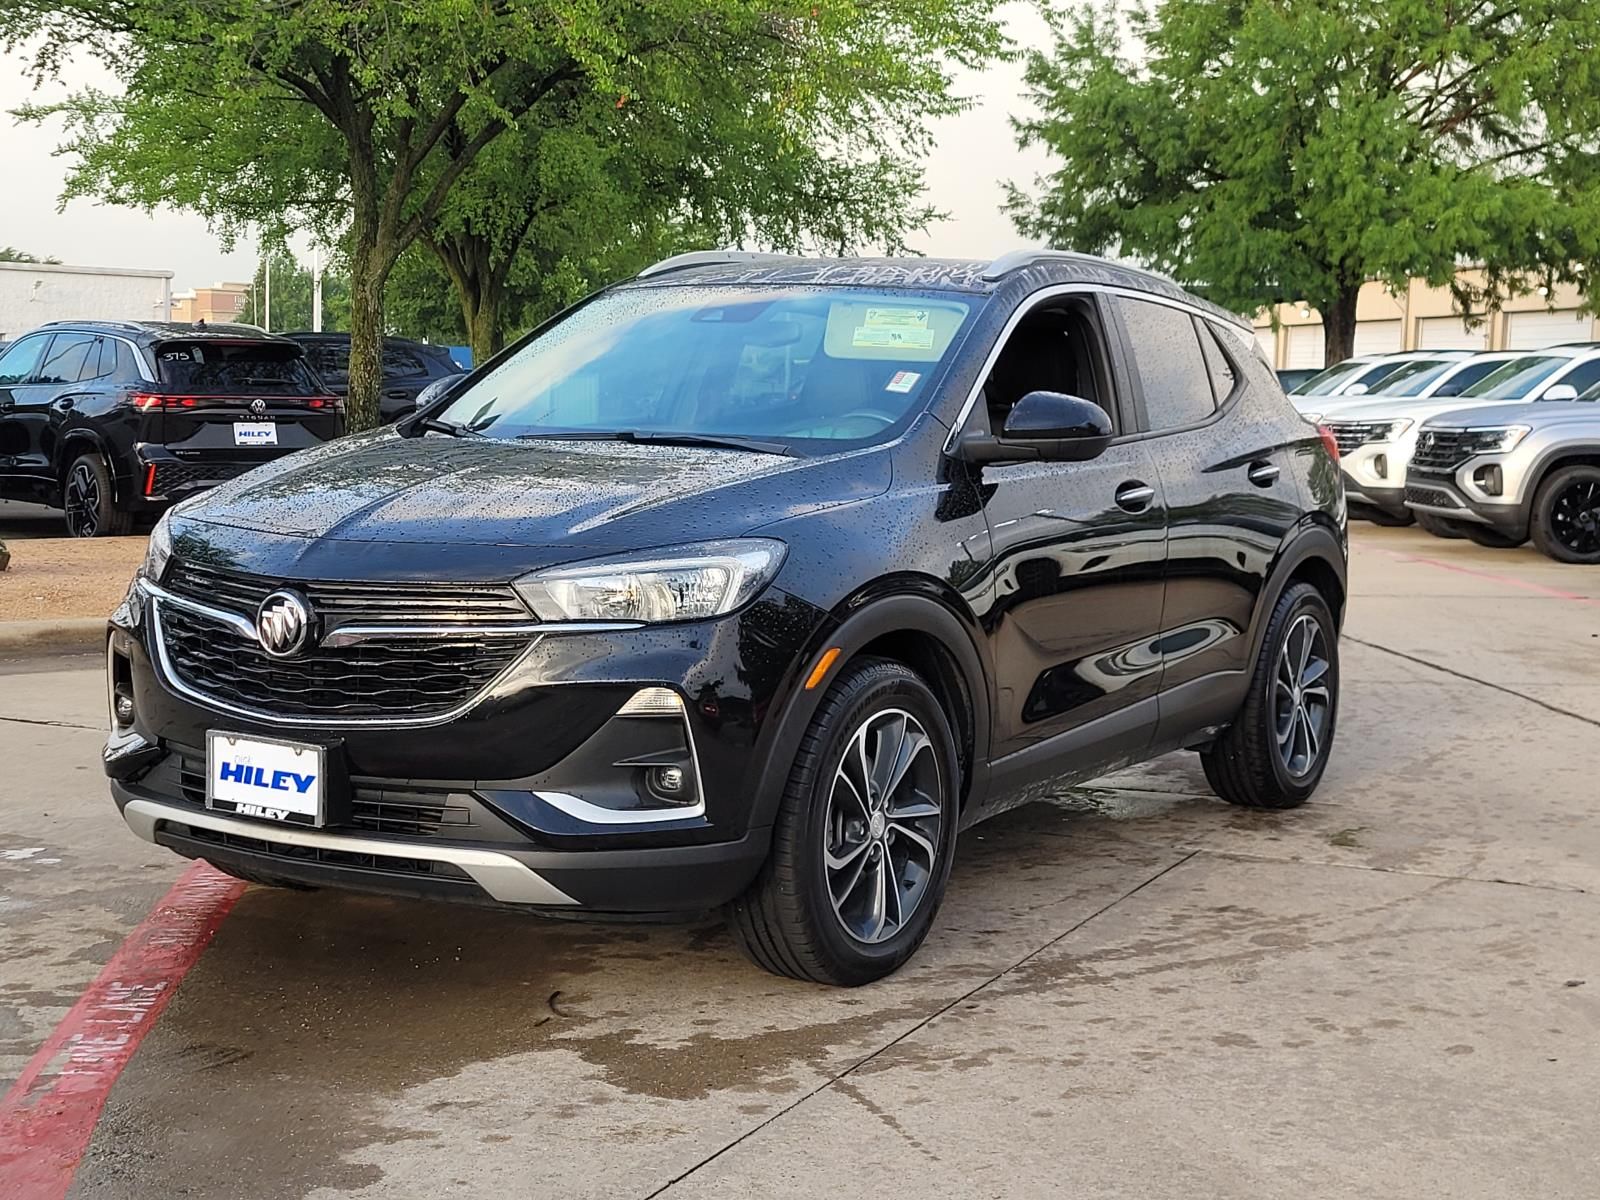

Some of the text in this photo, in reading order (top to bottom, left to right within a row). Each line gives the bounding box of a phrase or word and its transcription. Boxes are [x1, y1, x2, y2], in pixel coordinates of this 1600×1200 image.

[219, 761, 316, 794] HILEY
[235, 802, 290, 820] HILEY
[84, 981, 168, 1024] LANE
